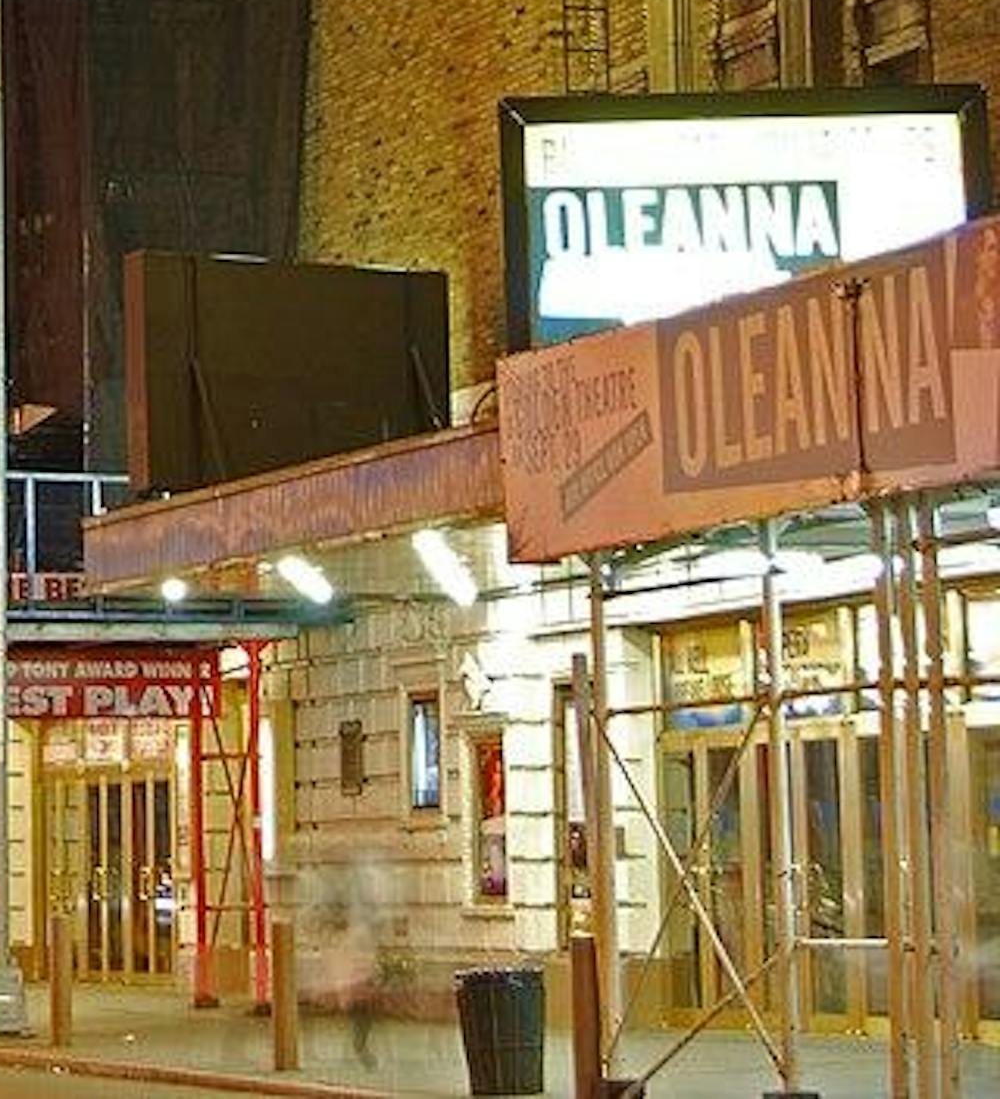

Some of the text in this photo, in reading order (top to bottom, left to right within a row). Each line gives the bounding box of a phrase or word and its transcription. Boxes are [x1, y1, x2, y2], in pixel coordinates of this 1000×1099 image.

[541, 184, 839, 258] OLEANNA
[22, 660, 69, 678] TONY
[74, 660, 138, 678] AWARD
[142, 660, 212, 678] WINNR
